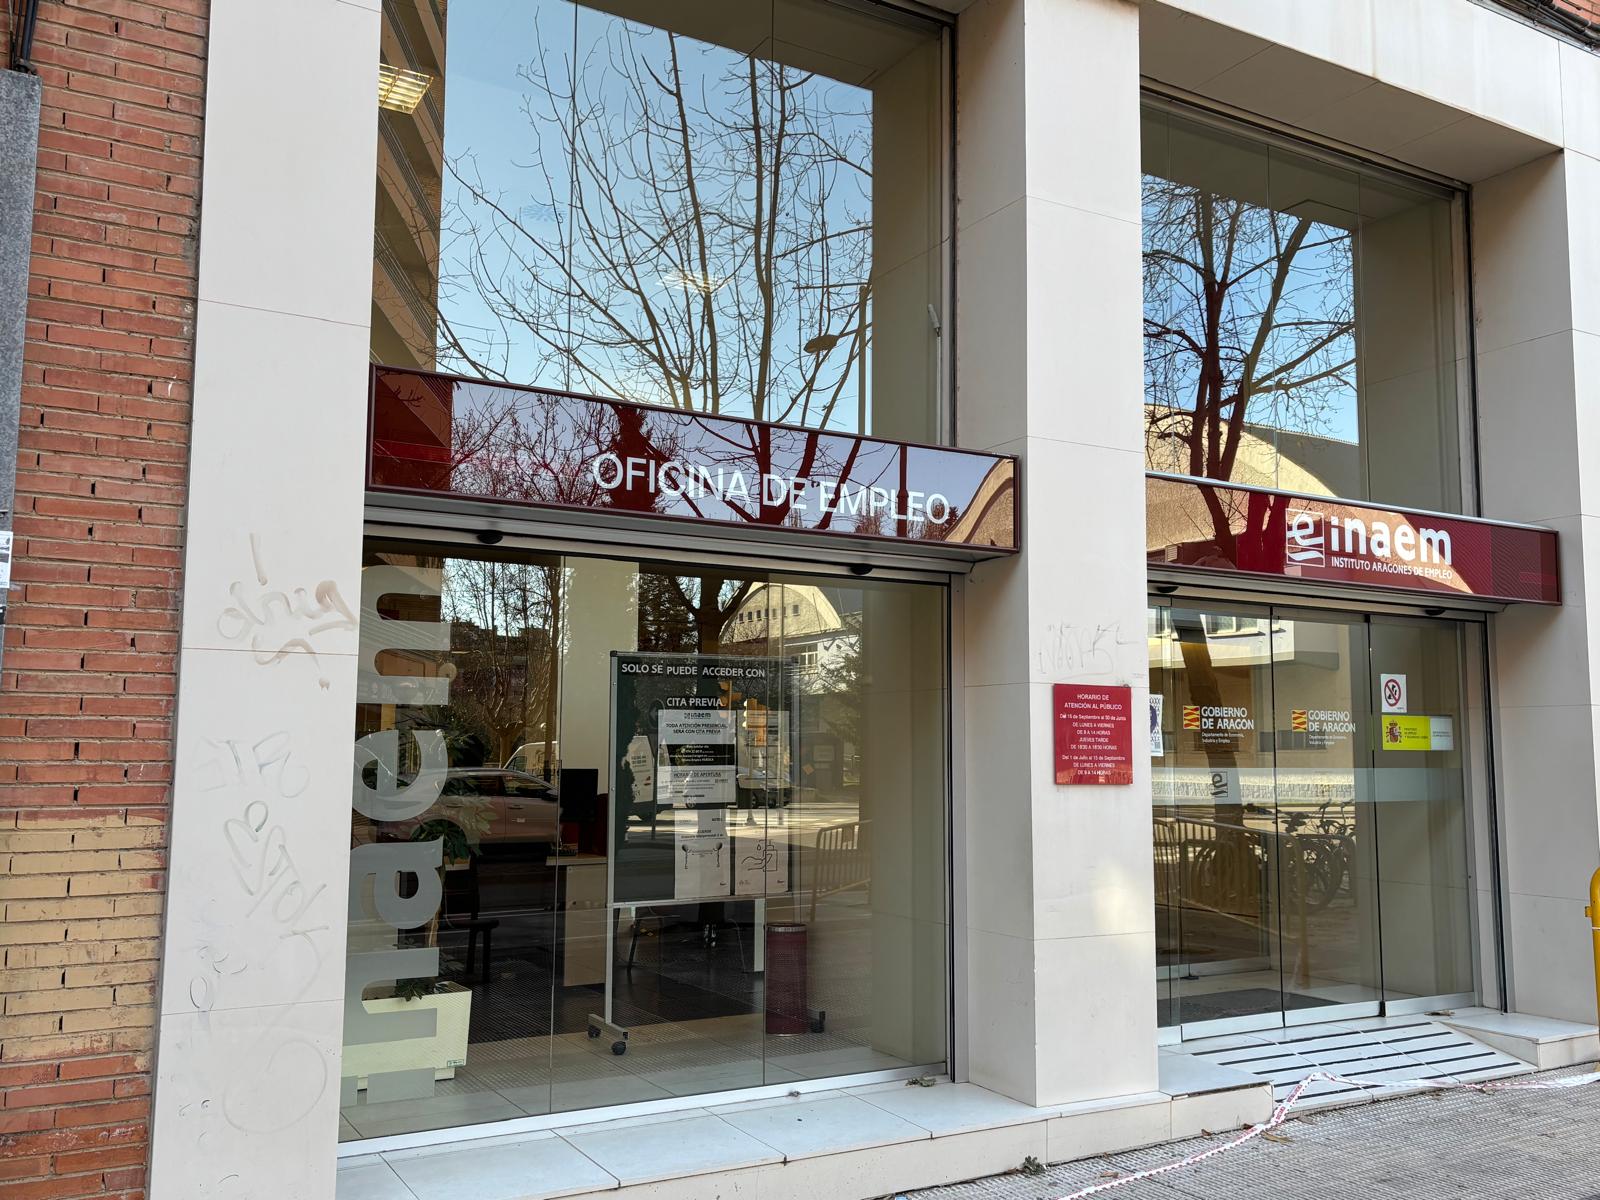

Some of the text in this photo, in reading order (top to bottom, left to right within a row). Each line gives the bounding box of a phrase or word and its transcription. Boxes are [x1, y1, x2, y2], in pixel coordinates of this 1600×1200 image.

[593, 452, 950, 524] OFICINA DE EMPLEO
[1330, 516, 1453, 566] inaem
[1331, 556, 1370, 571] INSTITUTO
[1413, 566, 1424, 577] DE
[1424, 567, 1453, 580] EMPLEO
[621, 663, 765, 678] SOLO SE PUEDE ACCEDER CON
[666, 697, 723, 707] CITA PREVIA
[1099, 702, 1122, 710] PÚBLICO
[1201, 705, 1248, 717] GOBIERNO
[1308, 709, 1350, 721] GOBIERNO
[1201, 719, 1214, 730] DE
[1308, 722, 1320, 733] DE
